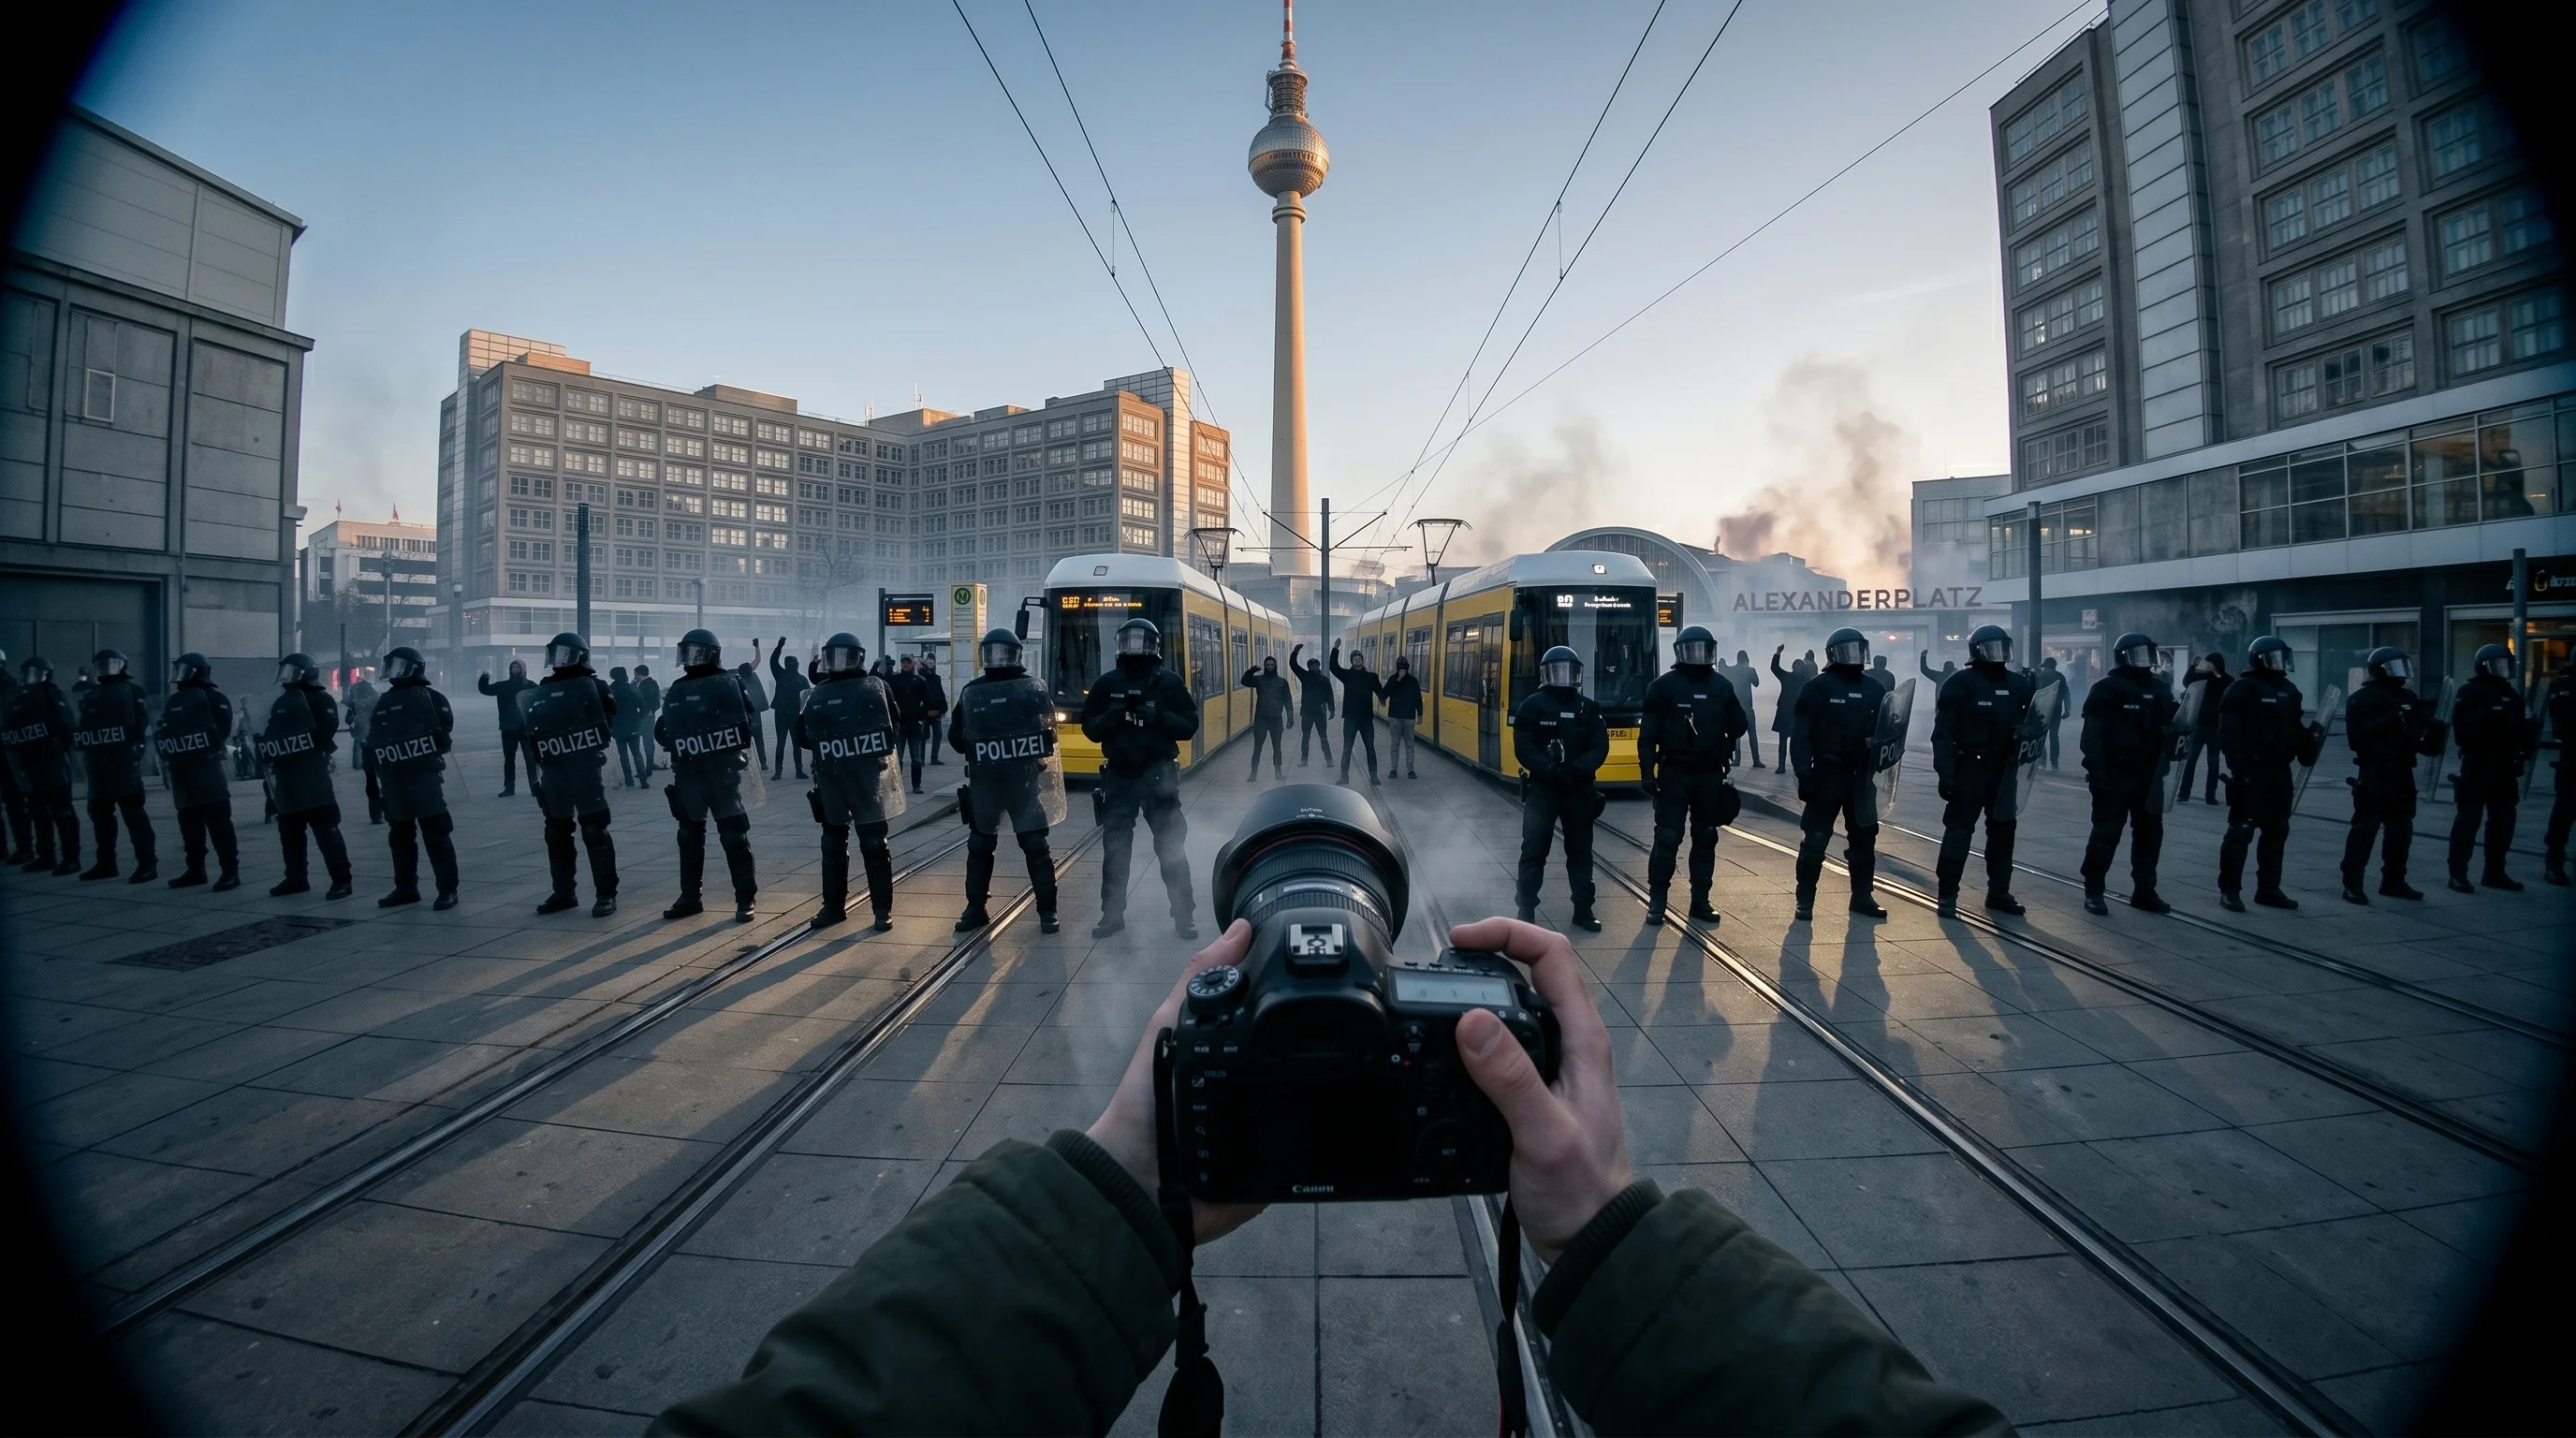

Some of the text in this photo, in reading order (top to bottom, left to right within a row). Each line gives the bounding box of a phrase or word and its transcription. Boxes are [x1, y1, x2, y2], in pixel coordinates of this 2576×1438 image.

[1733, 586, 1983, 611] ALEXANDERPLATZ
[1, 722, 49, 745] POLIZEI
[73, 726, 125, 748] POLIZEI
[157, 731, 210, 755] POLIZEI
[257, 732, 315, 759] POLIZEI
[536, 726, 603, 758] POLIZEI
[675, 726, 742, 757] POLIZEI
[819, 731, 887, 760] POLIZEI
[374, 735, 438, 765] POLIZEI
[975, 734, 1045, 761] POLIZEI
